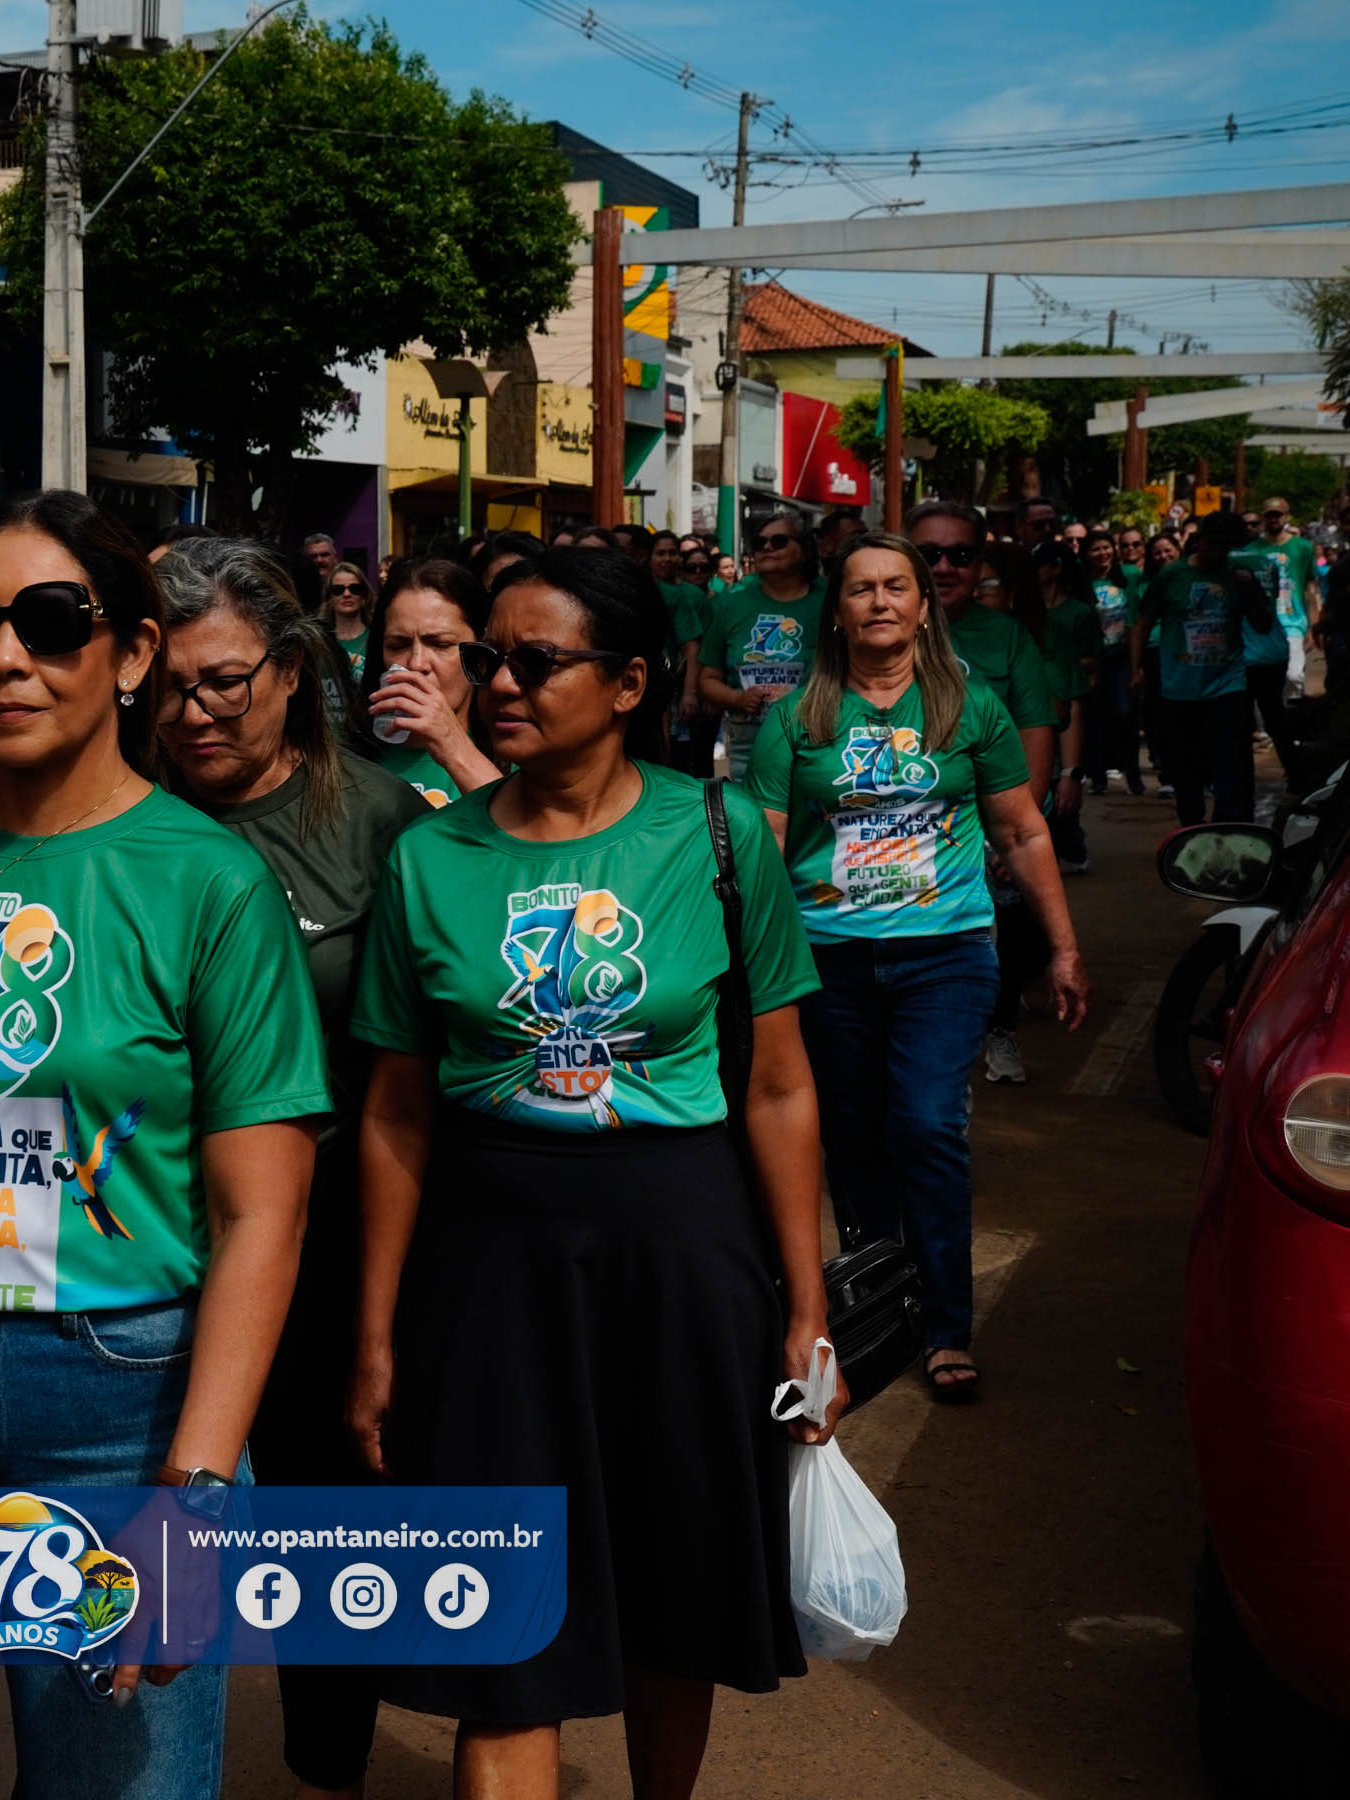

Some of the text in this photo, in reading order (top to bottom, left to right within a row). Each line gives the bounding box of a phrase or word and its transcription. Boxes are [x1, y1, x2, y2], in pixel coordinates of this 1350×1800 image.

[847, 864, 910, 880] FUTURO
[511, 886, 579, 912] BONITO
[300, 917, 325, 931] ito
[504, 889, 647, 1014] 78
[535, 1043, 612, 1069] ENCA
[11, 1129, 52, 1152] QUE
